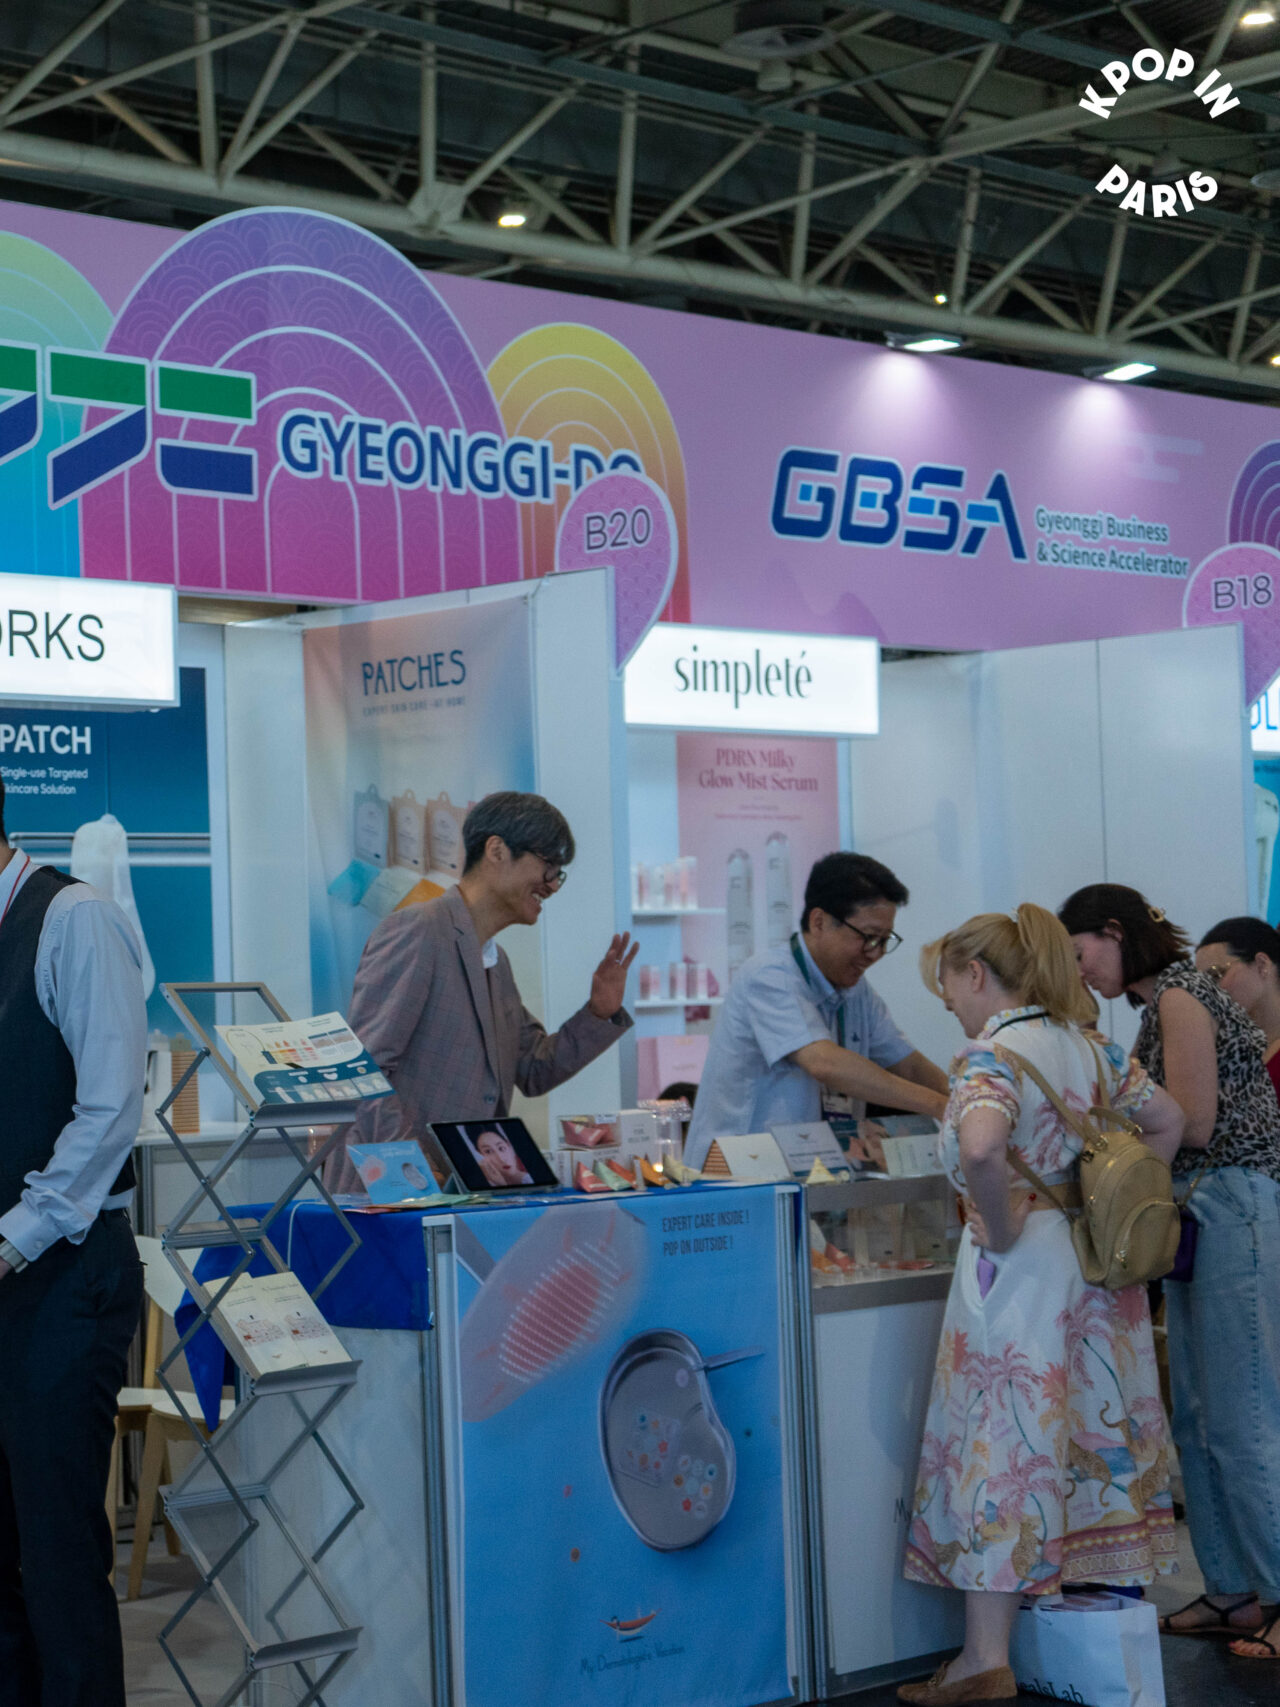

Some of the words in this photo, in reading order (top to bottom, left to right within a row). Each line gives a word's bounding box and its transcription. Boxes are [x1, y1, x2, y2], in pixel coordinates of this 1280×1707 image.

[771, 448, 1028, 561] GBSA
[585, 507, 651, 552] B20
[1035, 508, 1103, 540] Gyeonggi
[1107, 516, 1168, 542] Business
[1037, 542, 1047, 562] &
[1051, 542, 1106, 568] Science
[1109, 547, 1189, 576] Accelerator
[1213, 574, 1273, 610] B18
[361, 649, 466, 696] PATCHES
[674, 645, 813, 710] simpleté
[0, 766, 46, 781] Single-use
[48, 767, 88, 781] Targeted
[715, 748, 757, 769] PDRN
[760, 748, 796, 774] Milky
[4, 783, 40, 794] kincare
[40, 783, 77, 795] Solution
[699, 769, 734, 789] Glow
[738, 770, 768, 790] Mist
[771, 772, 819, 792] Serum
[662, 1215, 693, 1232] EXPERT
[694, 1212, 715, 1228] CARE
[718, 1209, 744, 1226] INSIDE
[663, 1240, 679, 1256] POP
[680, 1239, 692, 1255] ON
[693, 1235, 729, 1253] OUTSIDE
